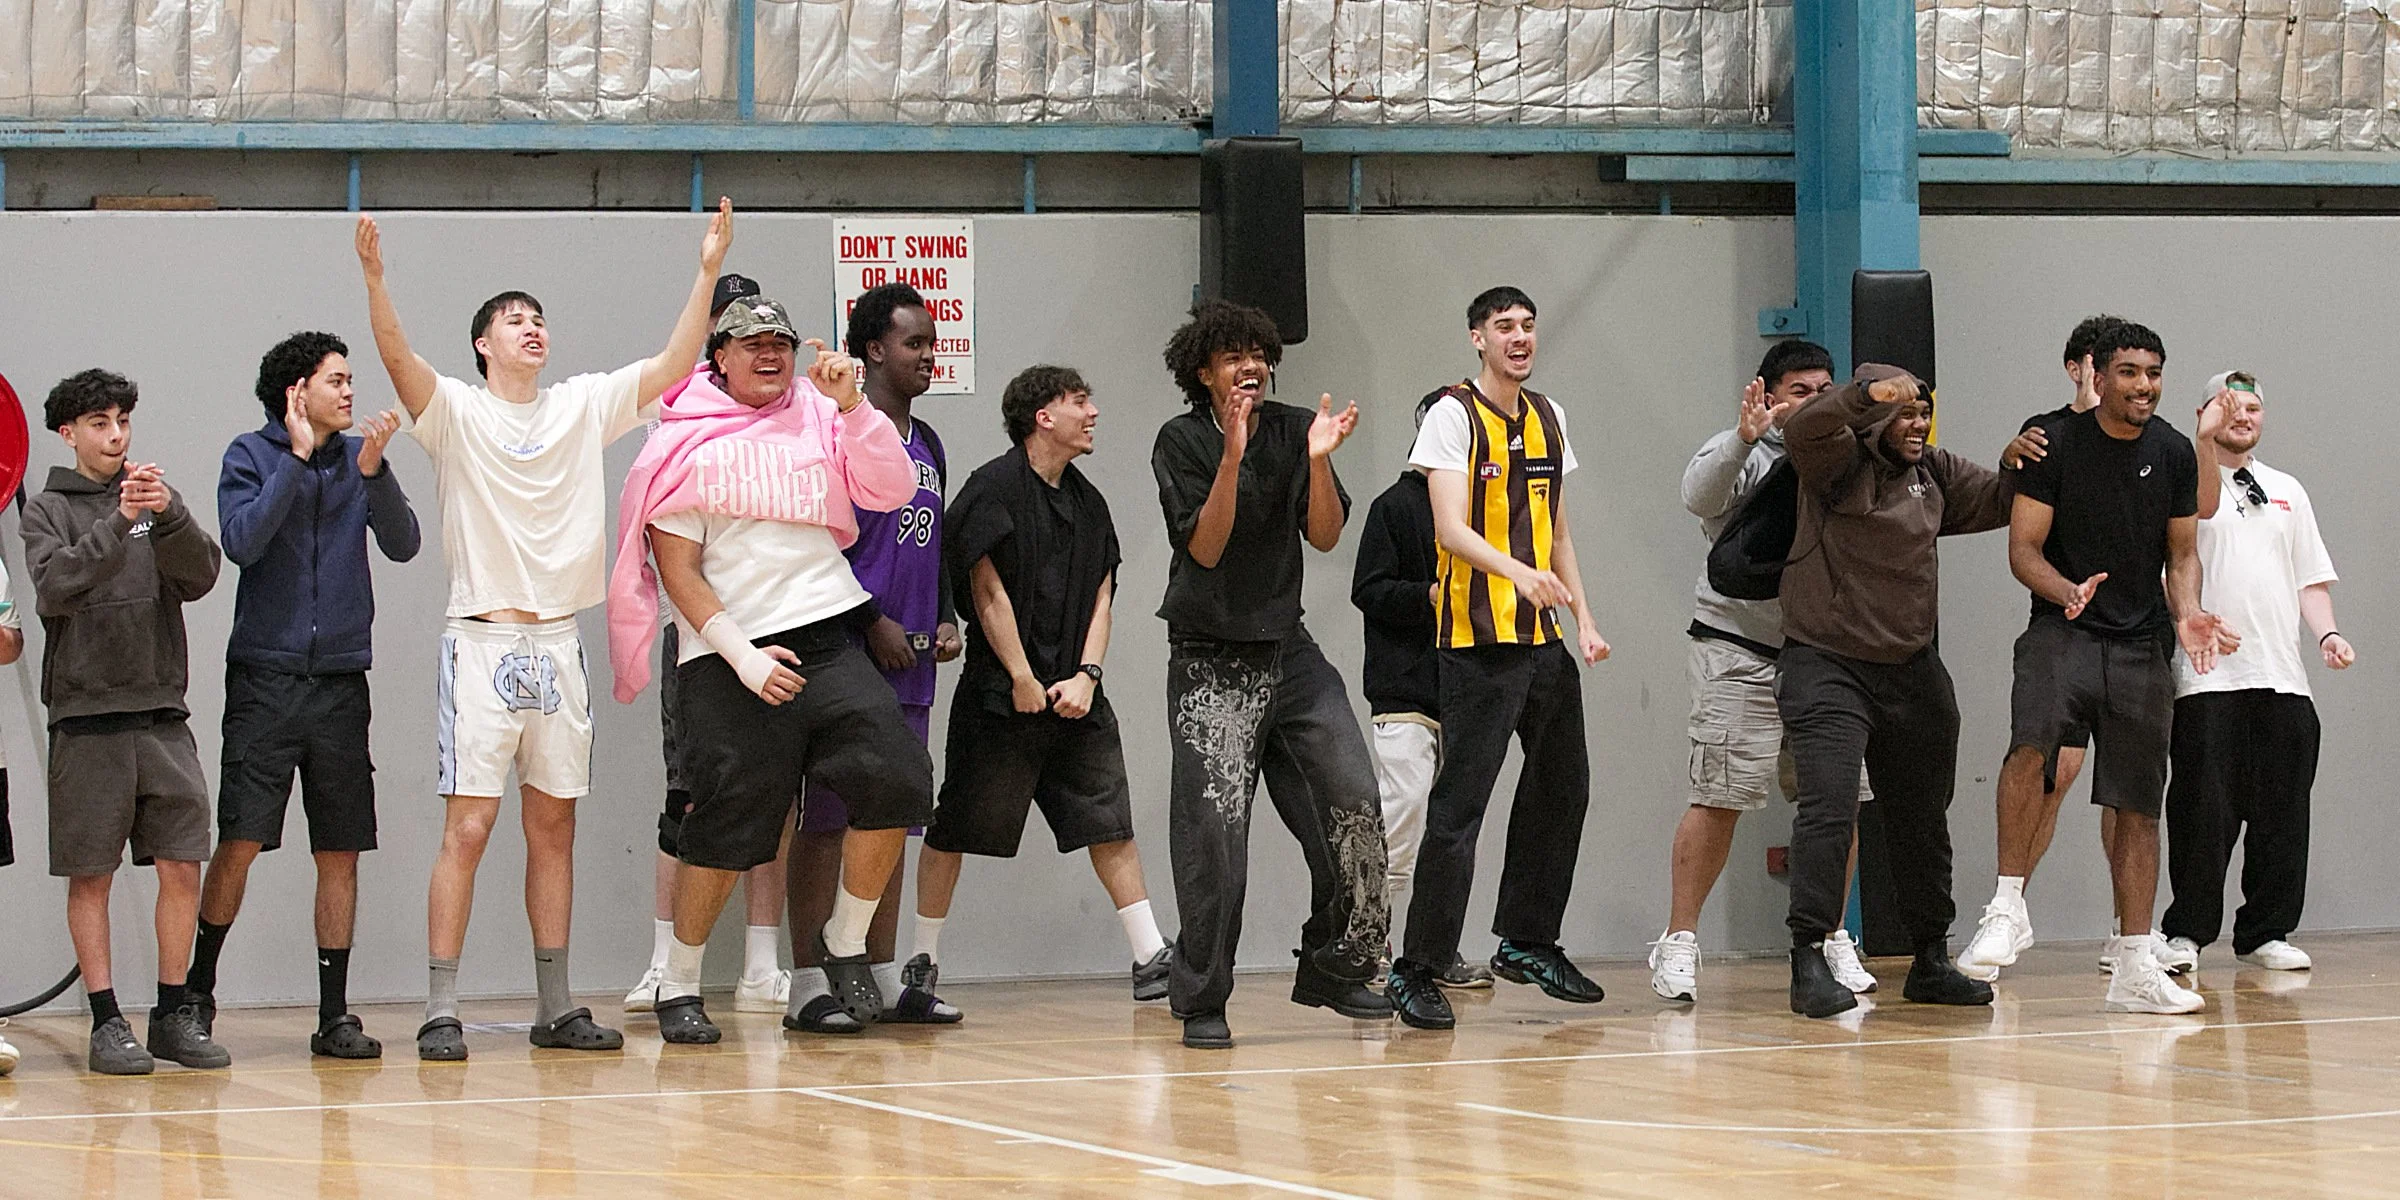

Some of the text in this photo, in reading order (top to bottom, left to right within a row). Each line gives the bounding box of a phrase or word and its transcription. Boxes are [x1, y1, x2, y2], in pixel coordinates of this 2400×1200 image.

[840, 236, 968, 259] DON'T SWING
[862, 268, 948, 290] OR HANG
[696, 440, 794, 504] FRONT
[707, 464, 829, 525] RUNNER
[897, 505, 935, 547] 98
